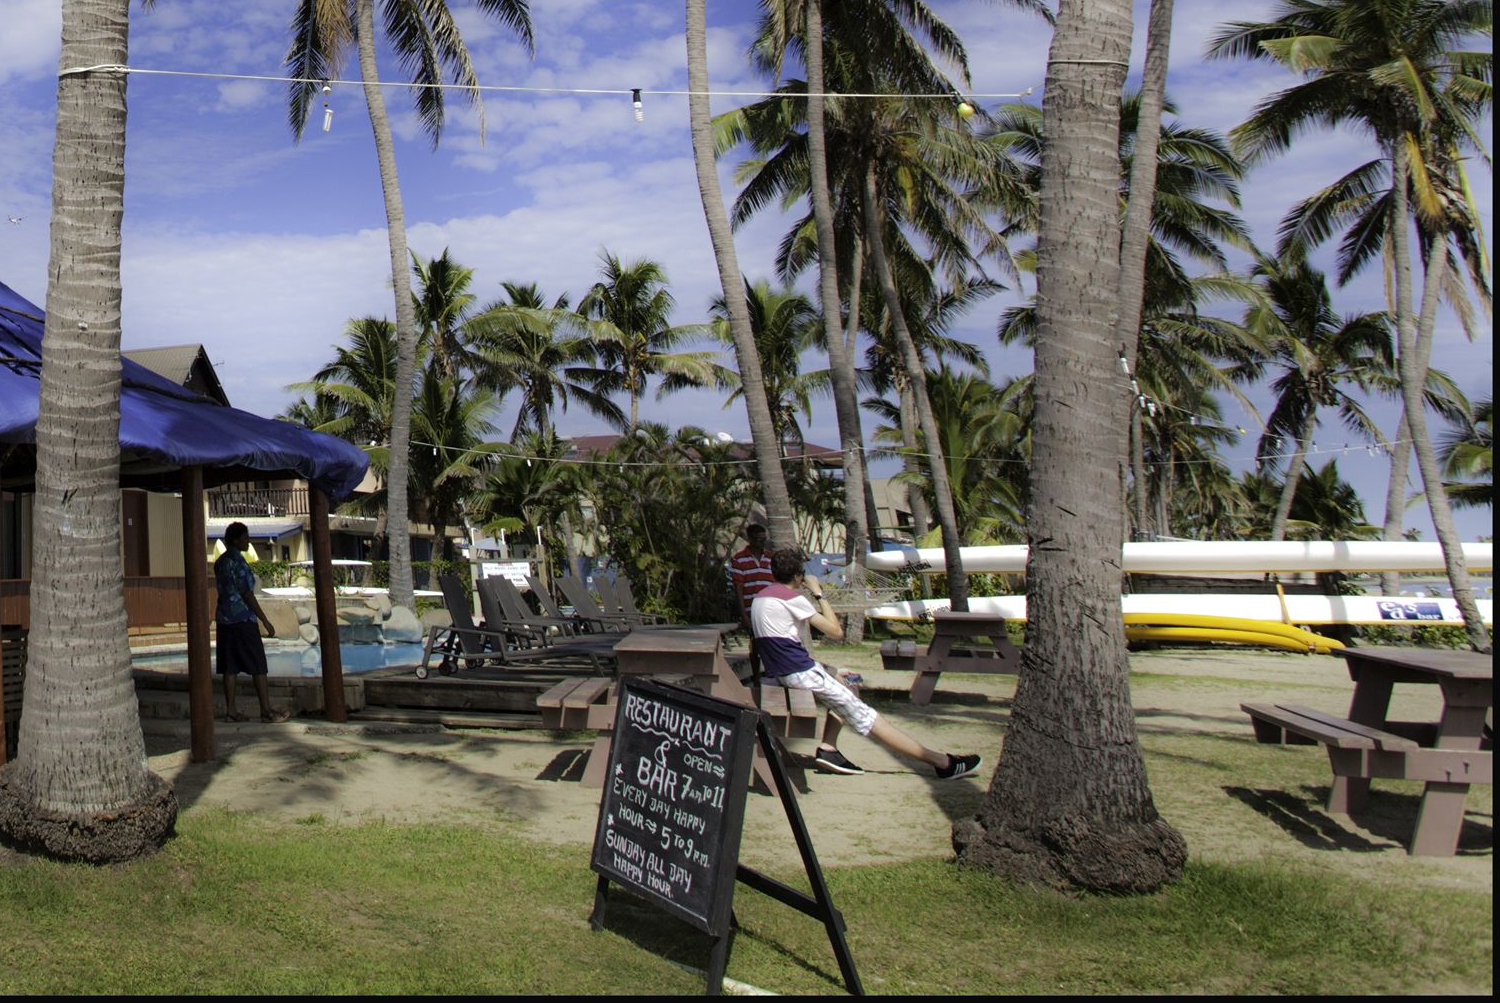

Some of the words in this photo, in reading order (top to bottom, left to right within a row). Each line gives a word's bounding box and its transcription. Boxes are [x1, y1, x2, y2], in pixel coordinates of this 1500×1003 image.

[625, 693, 731, 752] RESTAURANT
[637, 756, 677, 801] BAR
[683, 753, 712, 773] OPEN
[613, 777, 647, 807] EVERY
[649, 797, 670, 819] DAY
[673, 808, 706, 835] HAPPY
[618, 802, 644, 830] HOUR
[660, 826, 672, 850] 5
[605, 829, 645, 867] SUNDAY
[646, 852, 665, 875] ALL
[669, 862, 692, 893] DAY
[613, 852, 642, 883] HAPPY
